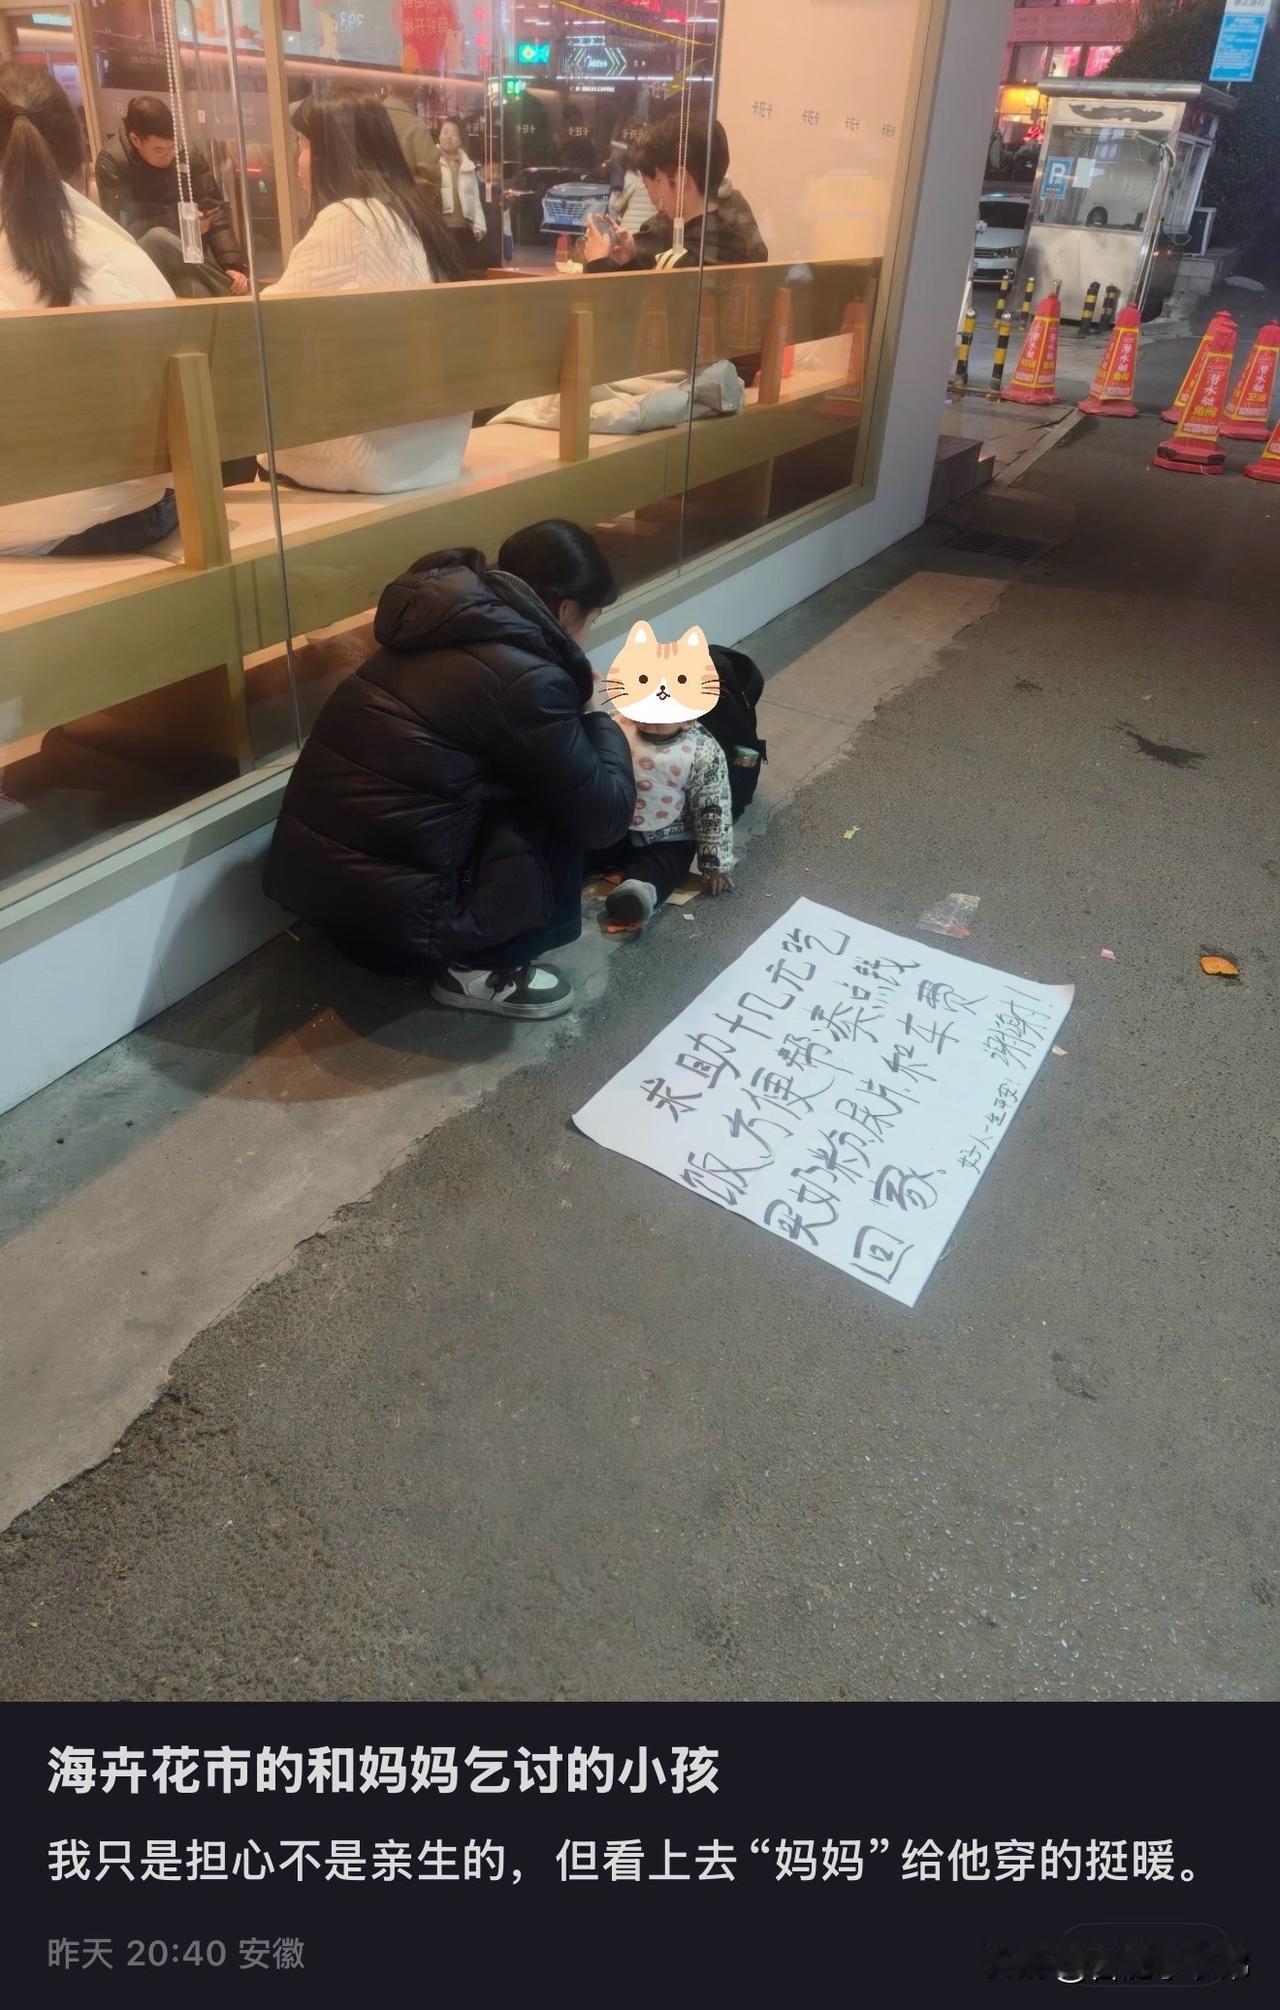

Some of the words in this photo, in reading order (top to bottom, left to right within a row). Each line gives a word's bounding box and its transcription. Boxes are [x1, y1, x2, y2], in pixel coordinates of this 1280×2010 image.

[1200, 373, 1221, 406] 潜水艇
[640, 929, 850, 1122] 求助十几元吃
